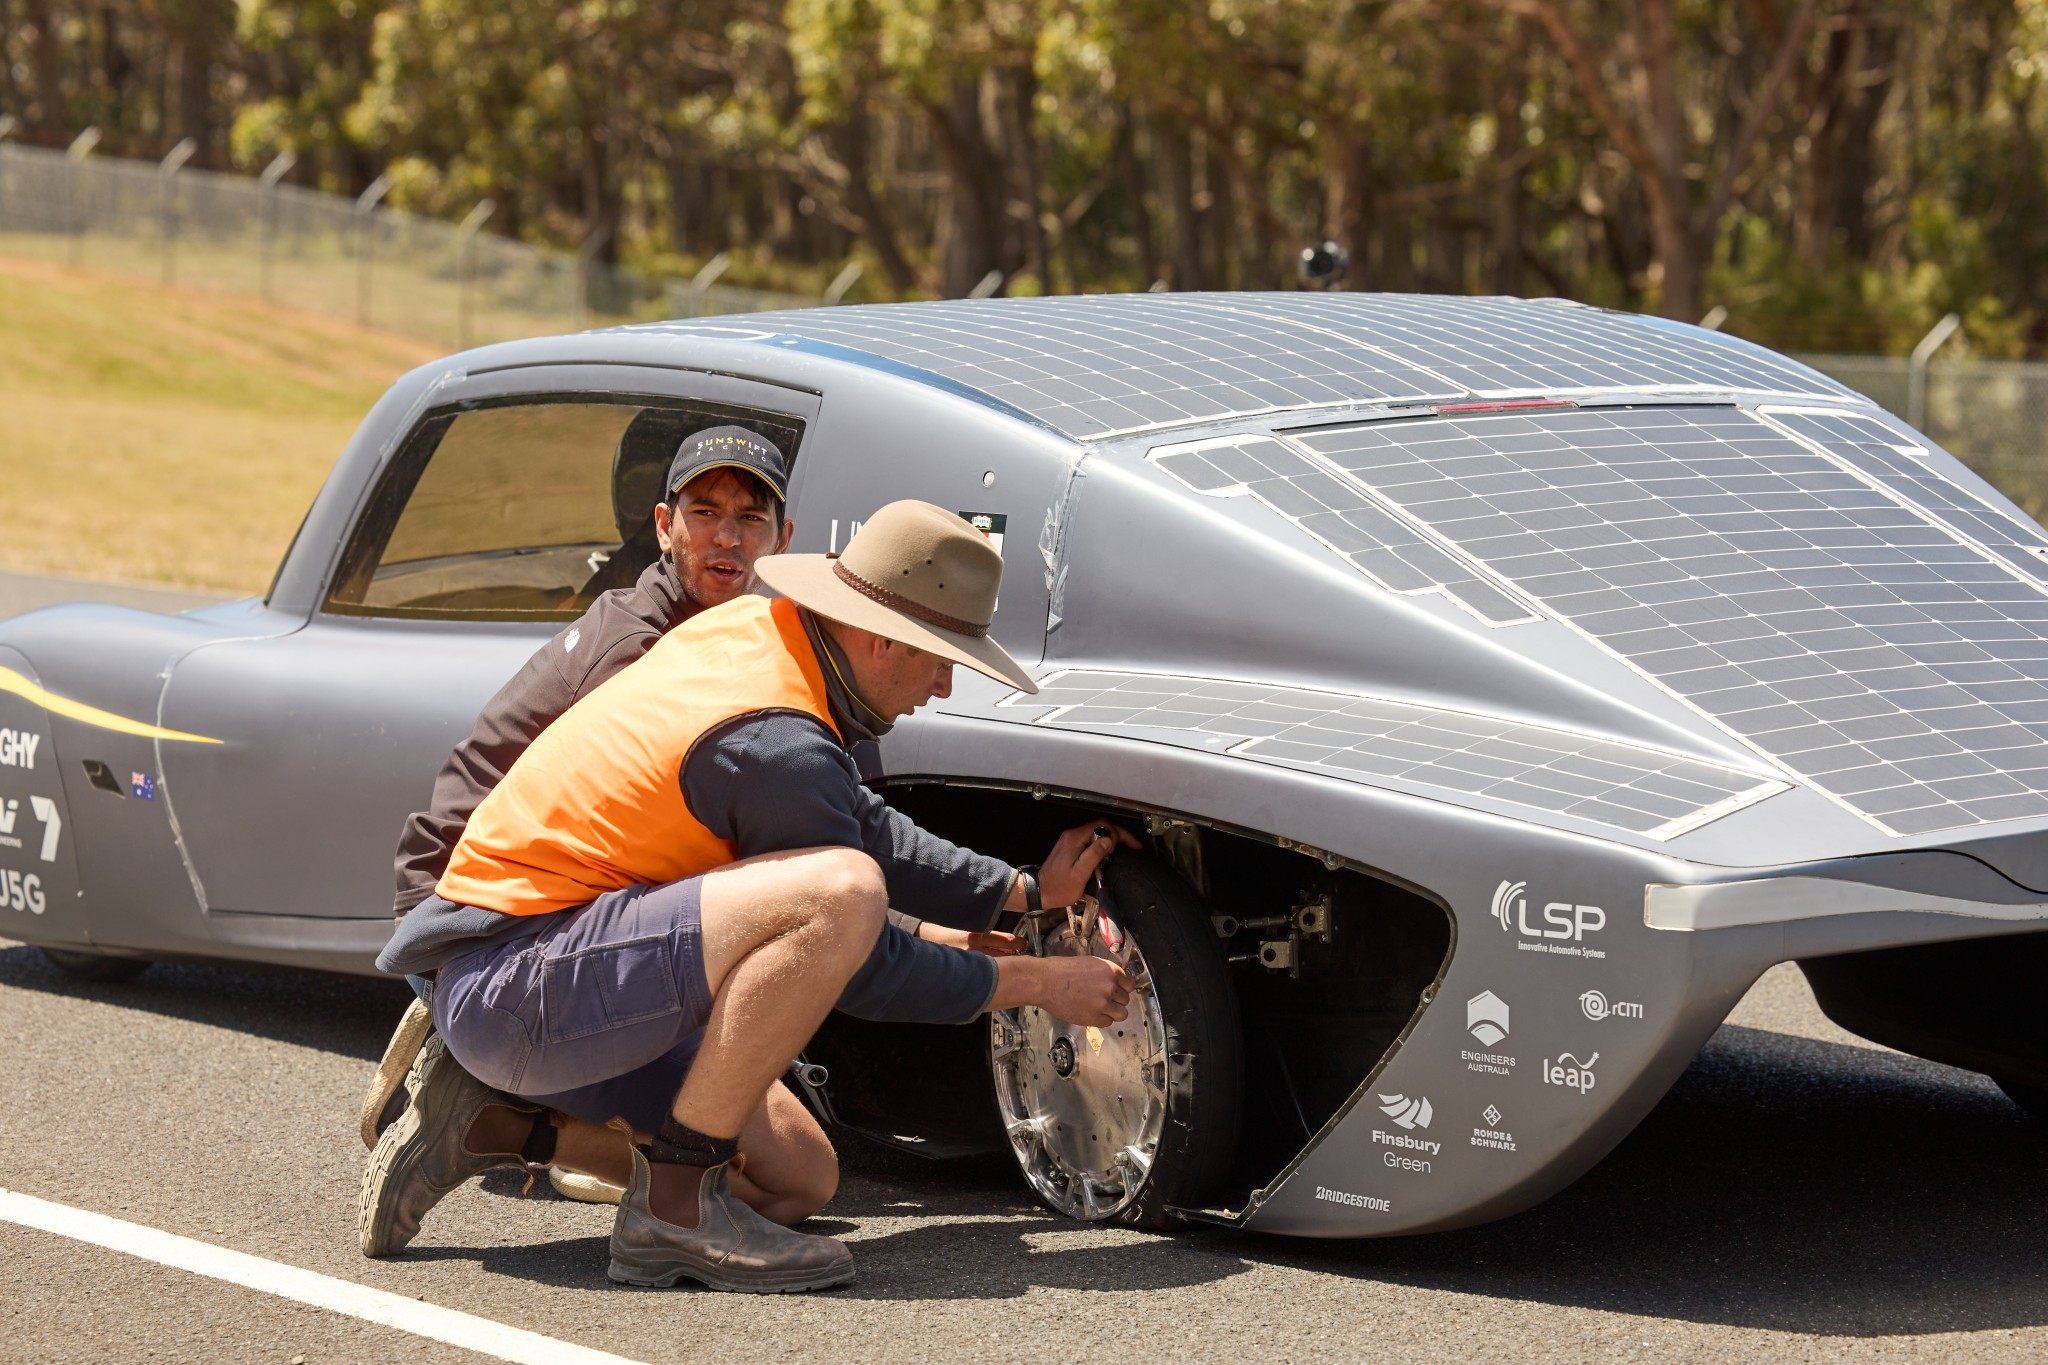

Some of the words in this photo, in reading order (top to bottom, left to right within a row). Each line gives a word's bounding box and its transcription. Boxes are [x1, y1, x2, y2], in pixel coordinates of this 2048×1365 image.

[697, 437, 767, 456] SUNSWIFT
[697, 444, 766, 462] RACING
[1518, 899, 1606, 941] LSP
[1517, 940, 1548, 953] Innovative
[1549, 943, 1581, 957] Automotive
[1582, 946, 1606, 959] Systems
[1461, 1050, 1516, 1067] ENGINEERS
[1467, 1063, 1510, 1076] AUSTRALIA
[1543, 1058, 1596, 1095] leap
[1372, 1130, 1441, 1156] Finsbury
[1470, 1137, 1517, 1152] SCHWARZ
[1383, 1152, 1432, 1174] Green
[1315, 1186, 1391, 1212] BRIDGESTONE
